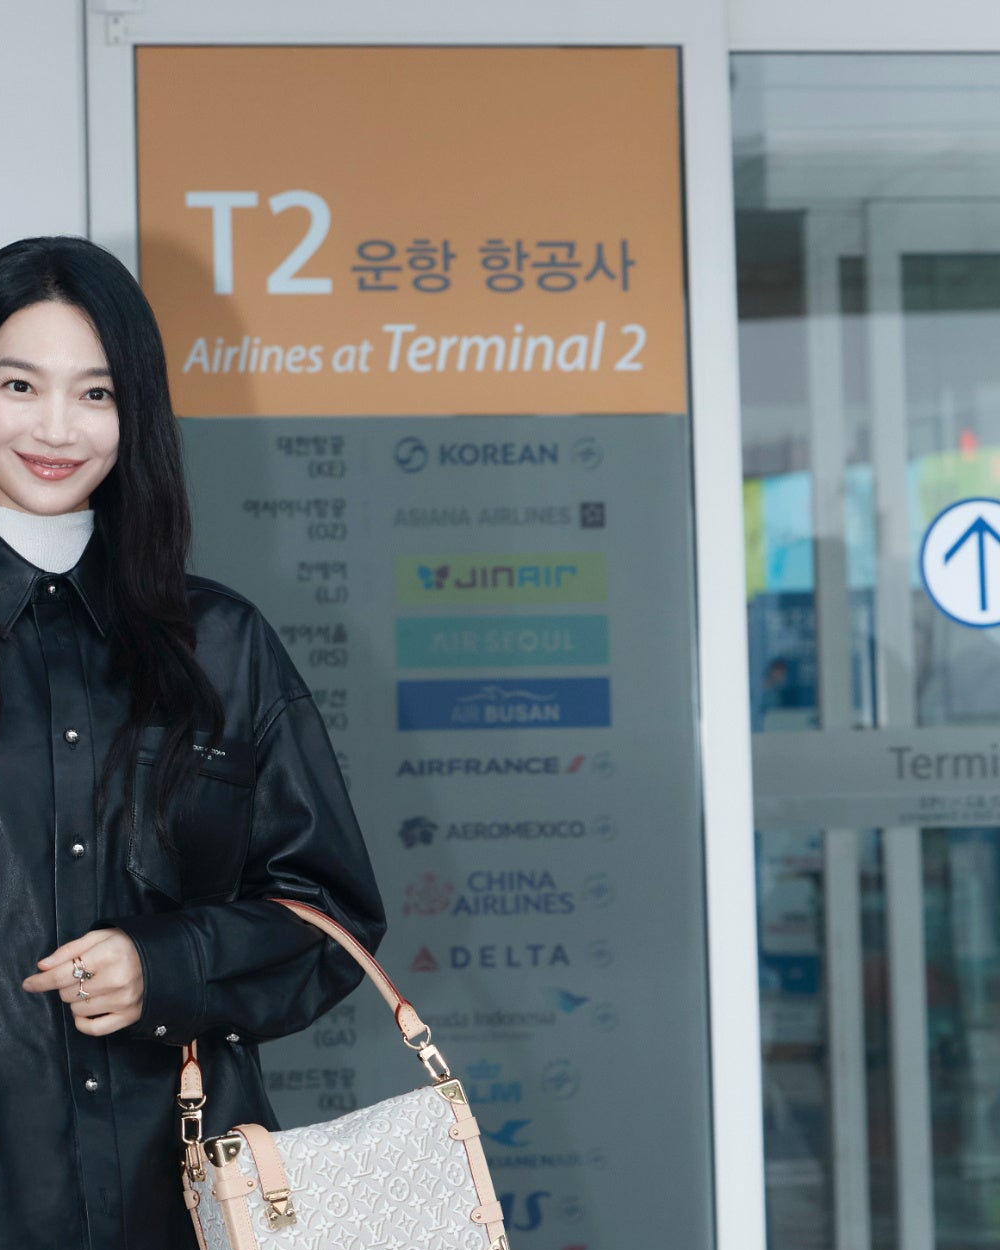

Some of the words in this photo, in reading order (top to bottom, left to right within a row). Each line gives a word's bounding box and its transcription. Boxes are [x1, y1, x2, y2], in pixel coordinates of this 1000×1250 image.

[184, 189, 333, 296] T2
[351, 238, 456, 293] 운항
[478, 238, 636, 293] 항공사
[182, 335, 324, 375] Airlines
[331, 340, 374, 374] at
[382, 321, 606, 374] Terminal
[614, 323, 648, 372] 2
[439, 443, 559, 466] KOREAN
[394, 505, 471, 528] ASIANA
[478, 502, 571, 526] AIRLINES
[484, 627, 574, 653] SEOUL
[484, 702, 560, 723] BUSAN
[446, 820, 585, 841] AEROMEXICO
[467, 870, 555, 892] CHINA
[453, 893, 575, 917] AIRLINES
[450, 944, 570, 970] DELTA
